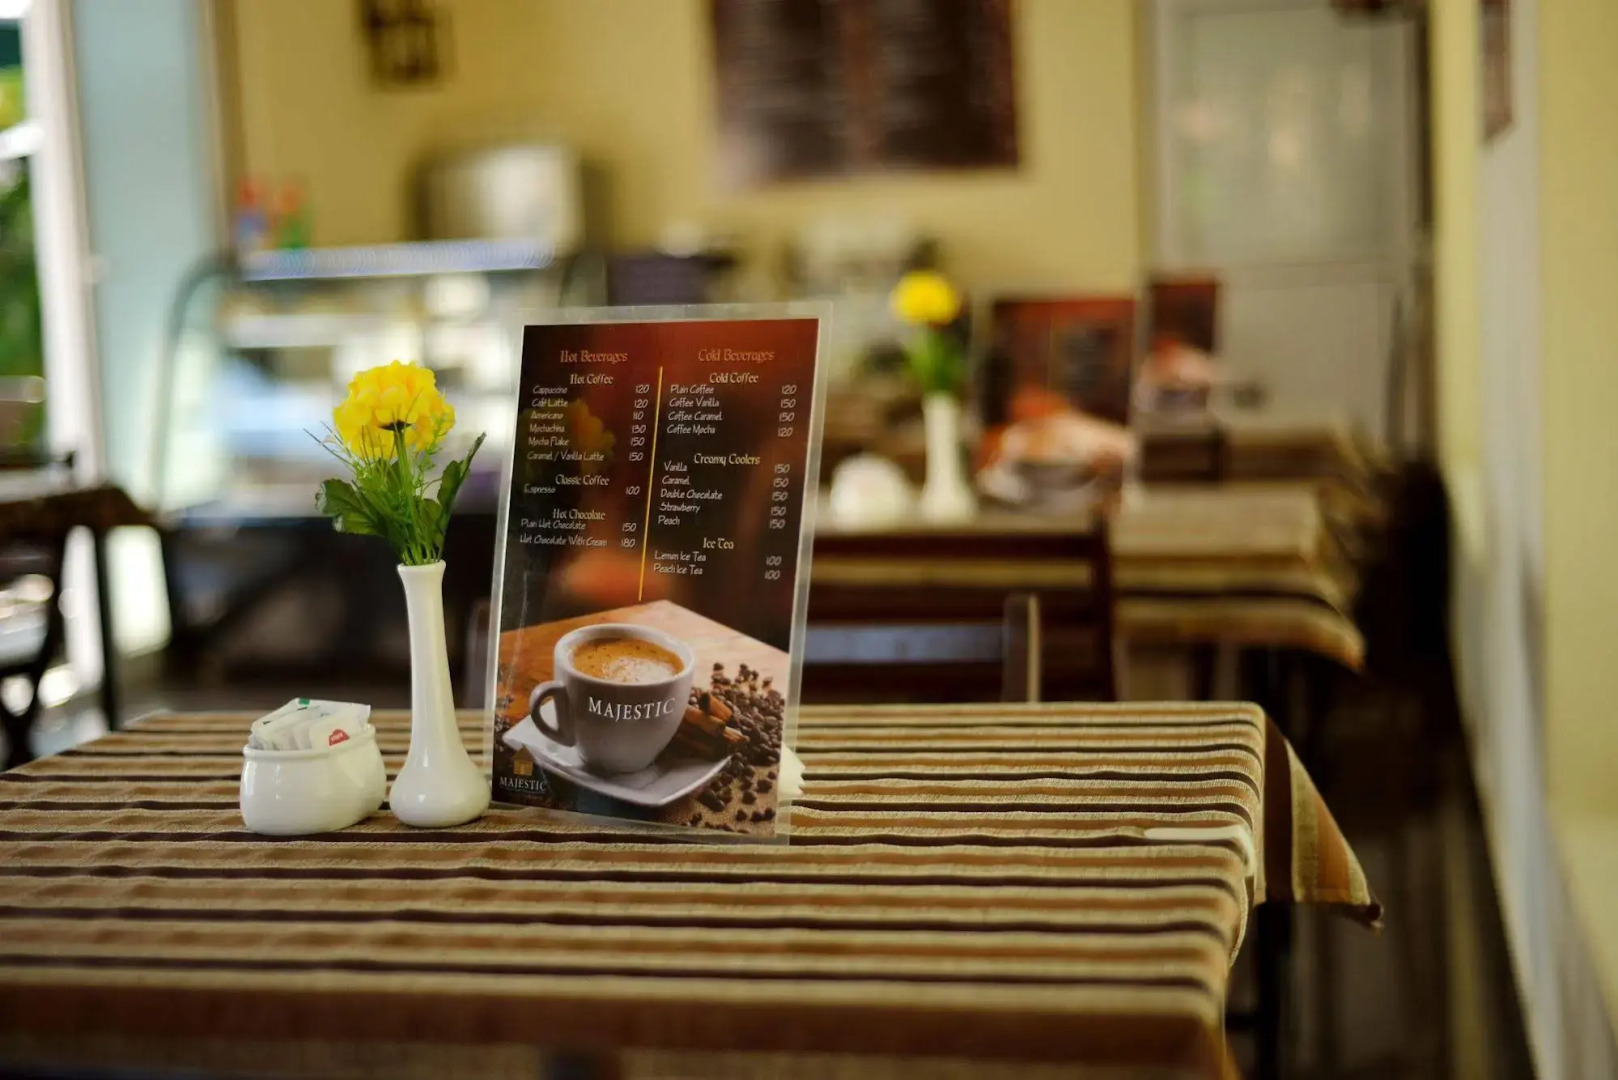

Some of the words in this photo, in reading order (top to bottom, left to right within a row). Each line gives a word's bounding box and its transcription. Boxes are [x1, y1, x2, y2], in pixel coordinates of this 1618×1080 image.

[560, 350, 577, 363] Hot
[580, 350, 628, 365] Beverages
[698, 349, 720, 361] Cold
[723, 349, 775, 364] Beverages
[570, 374, 585, 385] Hot
[586, 374, 614, 385] Coffee
[709, 372, 728, 384] Cold
[730, 372, 759, 384] Coffee
[532, 384, 568, 395] Cappuccino
[635, 384, 650, 394] 120
[670, 384, 689, 394] Plain
[689, 384, 715, 395] Coffee
[781, 384, 797, 395] 120
[547, 399, 568, 408] Latte
[634, 399, 649, 409] 120
[669, 398, 694, 408] Coffee
[696, 395, 720, 408] Vanilla
[780, 398, 797, 409] 150
[530, 411, 564, 420] Americano
[632, 411, 645, 421] 110
[668, 410, 693, 421] Coffee
[694, 411, 723, 421] Caramel
[779, 412, 795, 422] 150
[666, 424, 691, 435] Coffee
[692, 424, 716, 436] Mocha
[777, 427, 794, 437] 120
[528, 437, 550, 446] Mocha
[550, 436, 570, 446] Flake
[630, 437, 646, 447] 150
[526, 450, 554, 460] Caramel
[560, 449, 583, 460] Vanilla
[583, 451, 605, 461] Latte
[628, 452, 645, 462] 150
[694, 453, 727, 466] Creamy
[728, 453, 761, 465] Coolers
[663, 460, 688, 472] Vanilla
[774, 463, 791, 474] 150
[555, 474, 581, 486] Classic
[582, 475, 610, 486] Coffee
[661, 475, 690, 486] Caramel
[773, 477, 790, 488] 150
[524, 484, 556, 495] Espresso
[625, 486, 641, 496] 100
[660, 488, 685, 499] Double
[686, 489, 723, 500] Chocolate
[771, 491, 788, 502] 150
[659, 502, 701, 514] Strawberry
[770, 506, 787, 517] 150
[552, 508, 567, 520] Hot
[568, 508, 606, 521] Chocolate
[520, 518, 538, 528] Plain
[538, 518, 552, 529] Hot
[552, 519, 586, 531] Chocolate
[657, 515, 681, 526] Peach
[769, 519, 786, 530] 150
[622, 522, 637, 533] 150
[519, 533, 533, 544] Hot
[533, 534, 567, 546] Chocolate
[585, 536, 608, 548] Cream
[620, 537, 636, 548] 180
[703, 537, 717, 549] Ice
[717, 537, 734, 550] Tea
[654, 550, 679, 561] Lemon
[679, 550, 691, 561] Ice
[692, 551, 707, 562] Tea
[765, 556, 782, 566] 100
[653, 562, 676, 573] Peach
[676, 563, 688, 575] Ice
[689, 564, 704, 575] Tea
[764, 570, 780, 580] 100
[588, 696, 677, 722] MAJESTIC
[500, 776, 547, 791] MAJESTIC
